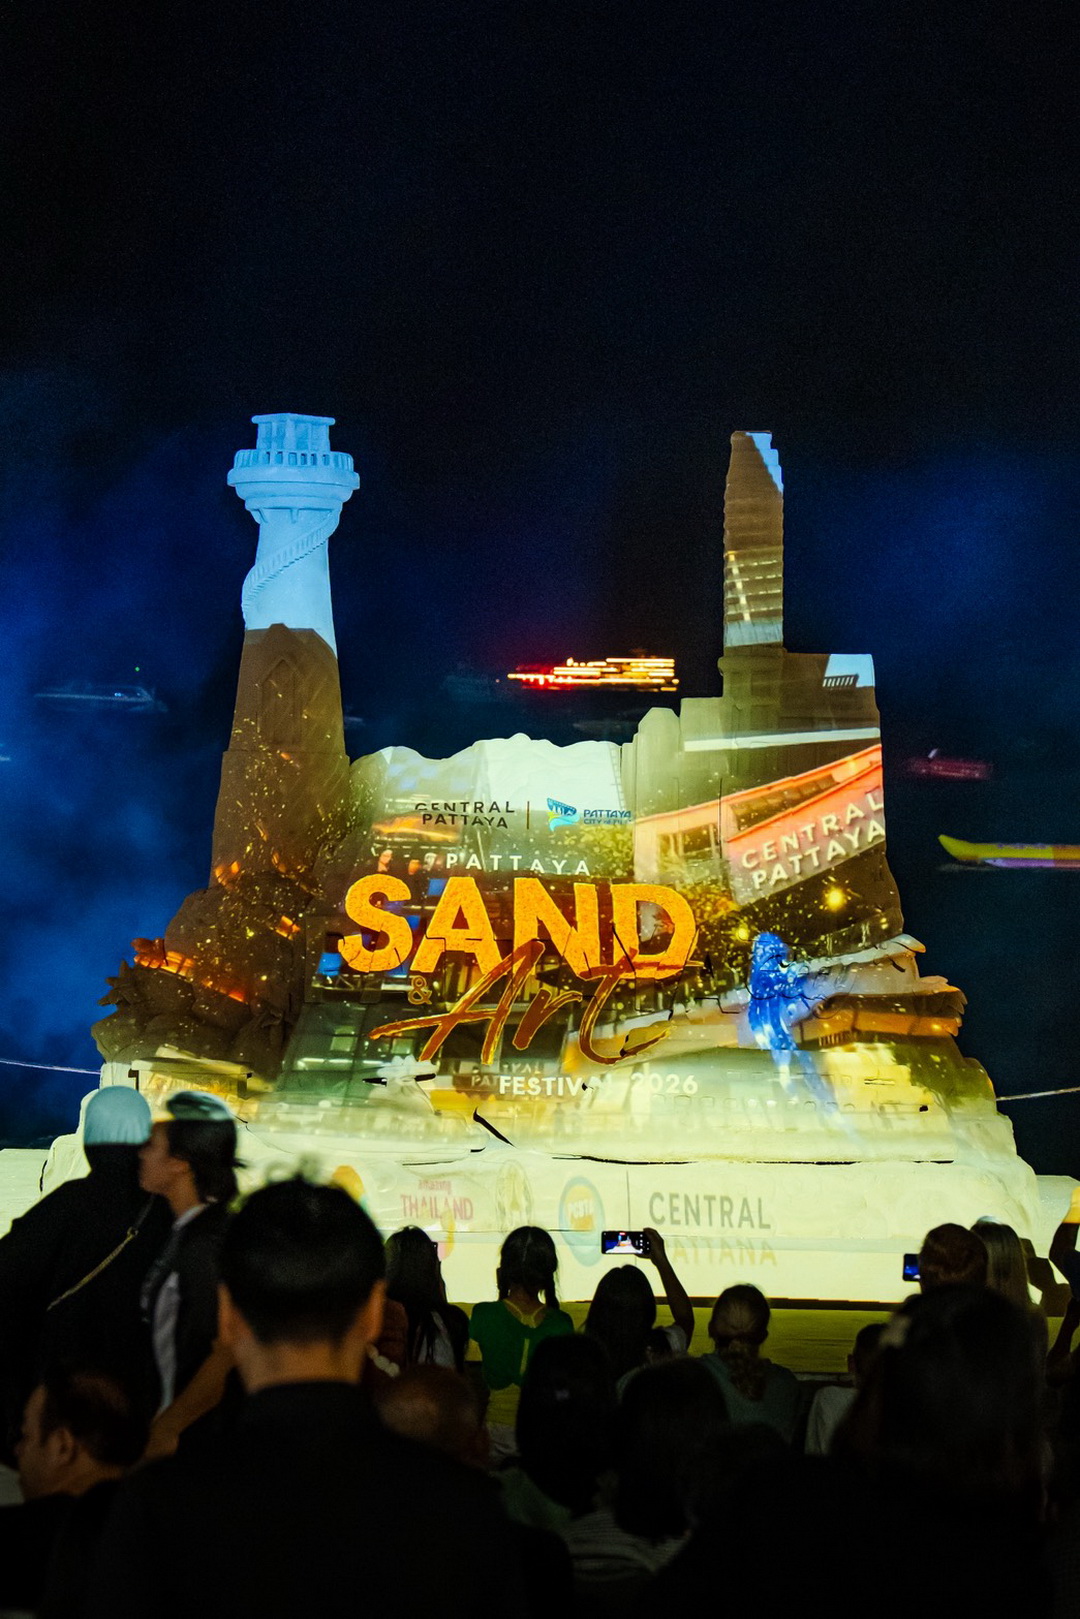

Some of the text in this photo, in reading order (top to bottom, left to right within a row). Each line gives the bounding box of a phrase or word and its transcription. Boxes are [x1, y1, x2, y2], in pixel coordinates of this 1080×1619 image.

[414, 801, 515, 813] CENTRAL
[422, 813, 508, 829] PATTAYA
[583, 809, 632, 818] PATTAYA
[741, 791, 884, 869] CENTRAL
[446, 853, 591, 876] PATTAYA
[751, 819, 886, 890] PATTAYA
[337, 873, 697, 980] SAND
[368, 938, 704, 1066] Art
[407, 974, 433, 1005] &
[630, 1072, 699, 1095] 2026
[648, 1191, 772, 1230] CENTRAL
[666, 1237, 778, 1267] ATTANA
